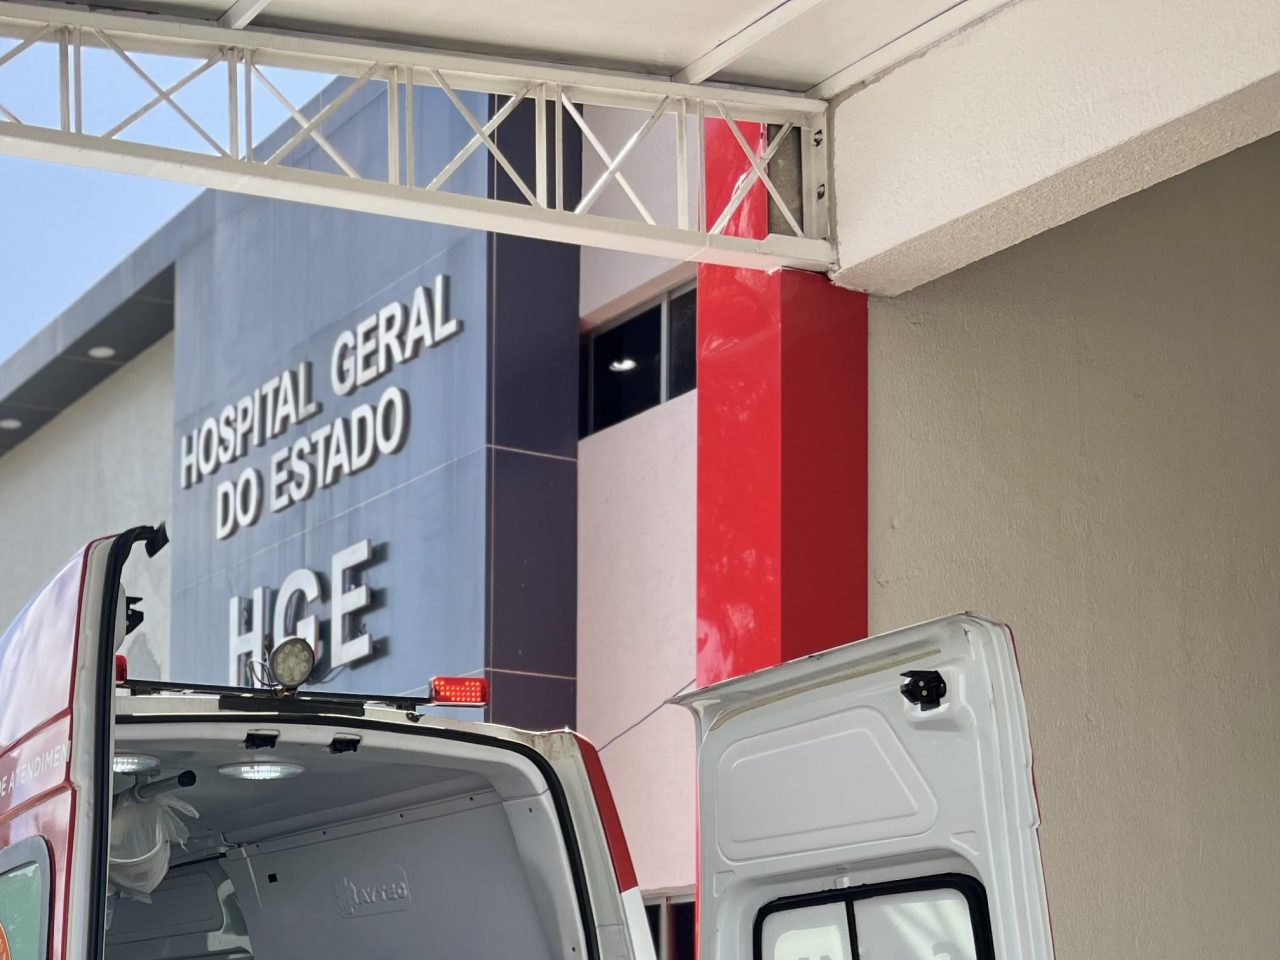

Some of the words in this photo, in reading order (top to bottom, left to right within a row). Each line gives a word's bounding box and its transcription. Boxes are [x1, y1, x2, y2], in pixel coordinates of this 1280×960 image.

[180, 361, 321, 489] HOSPITAL
[330, 274, 462, 396] GERAL
[216, 467, 259, 540] DO
[271, 386, 407, 512] ESTADO
[228, 539, 374, 690] HGE
